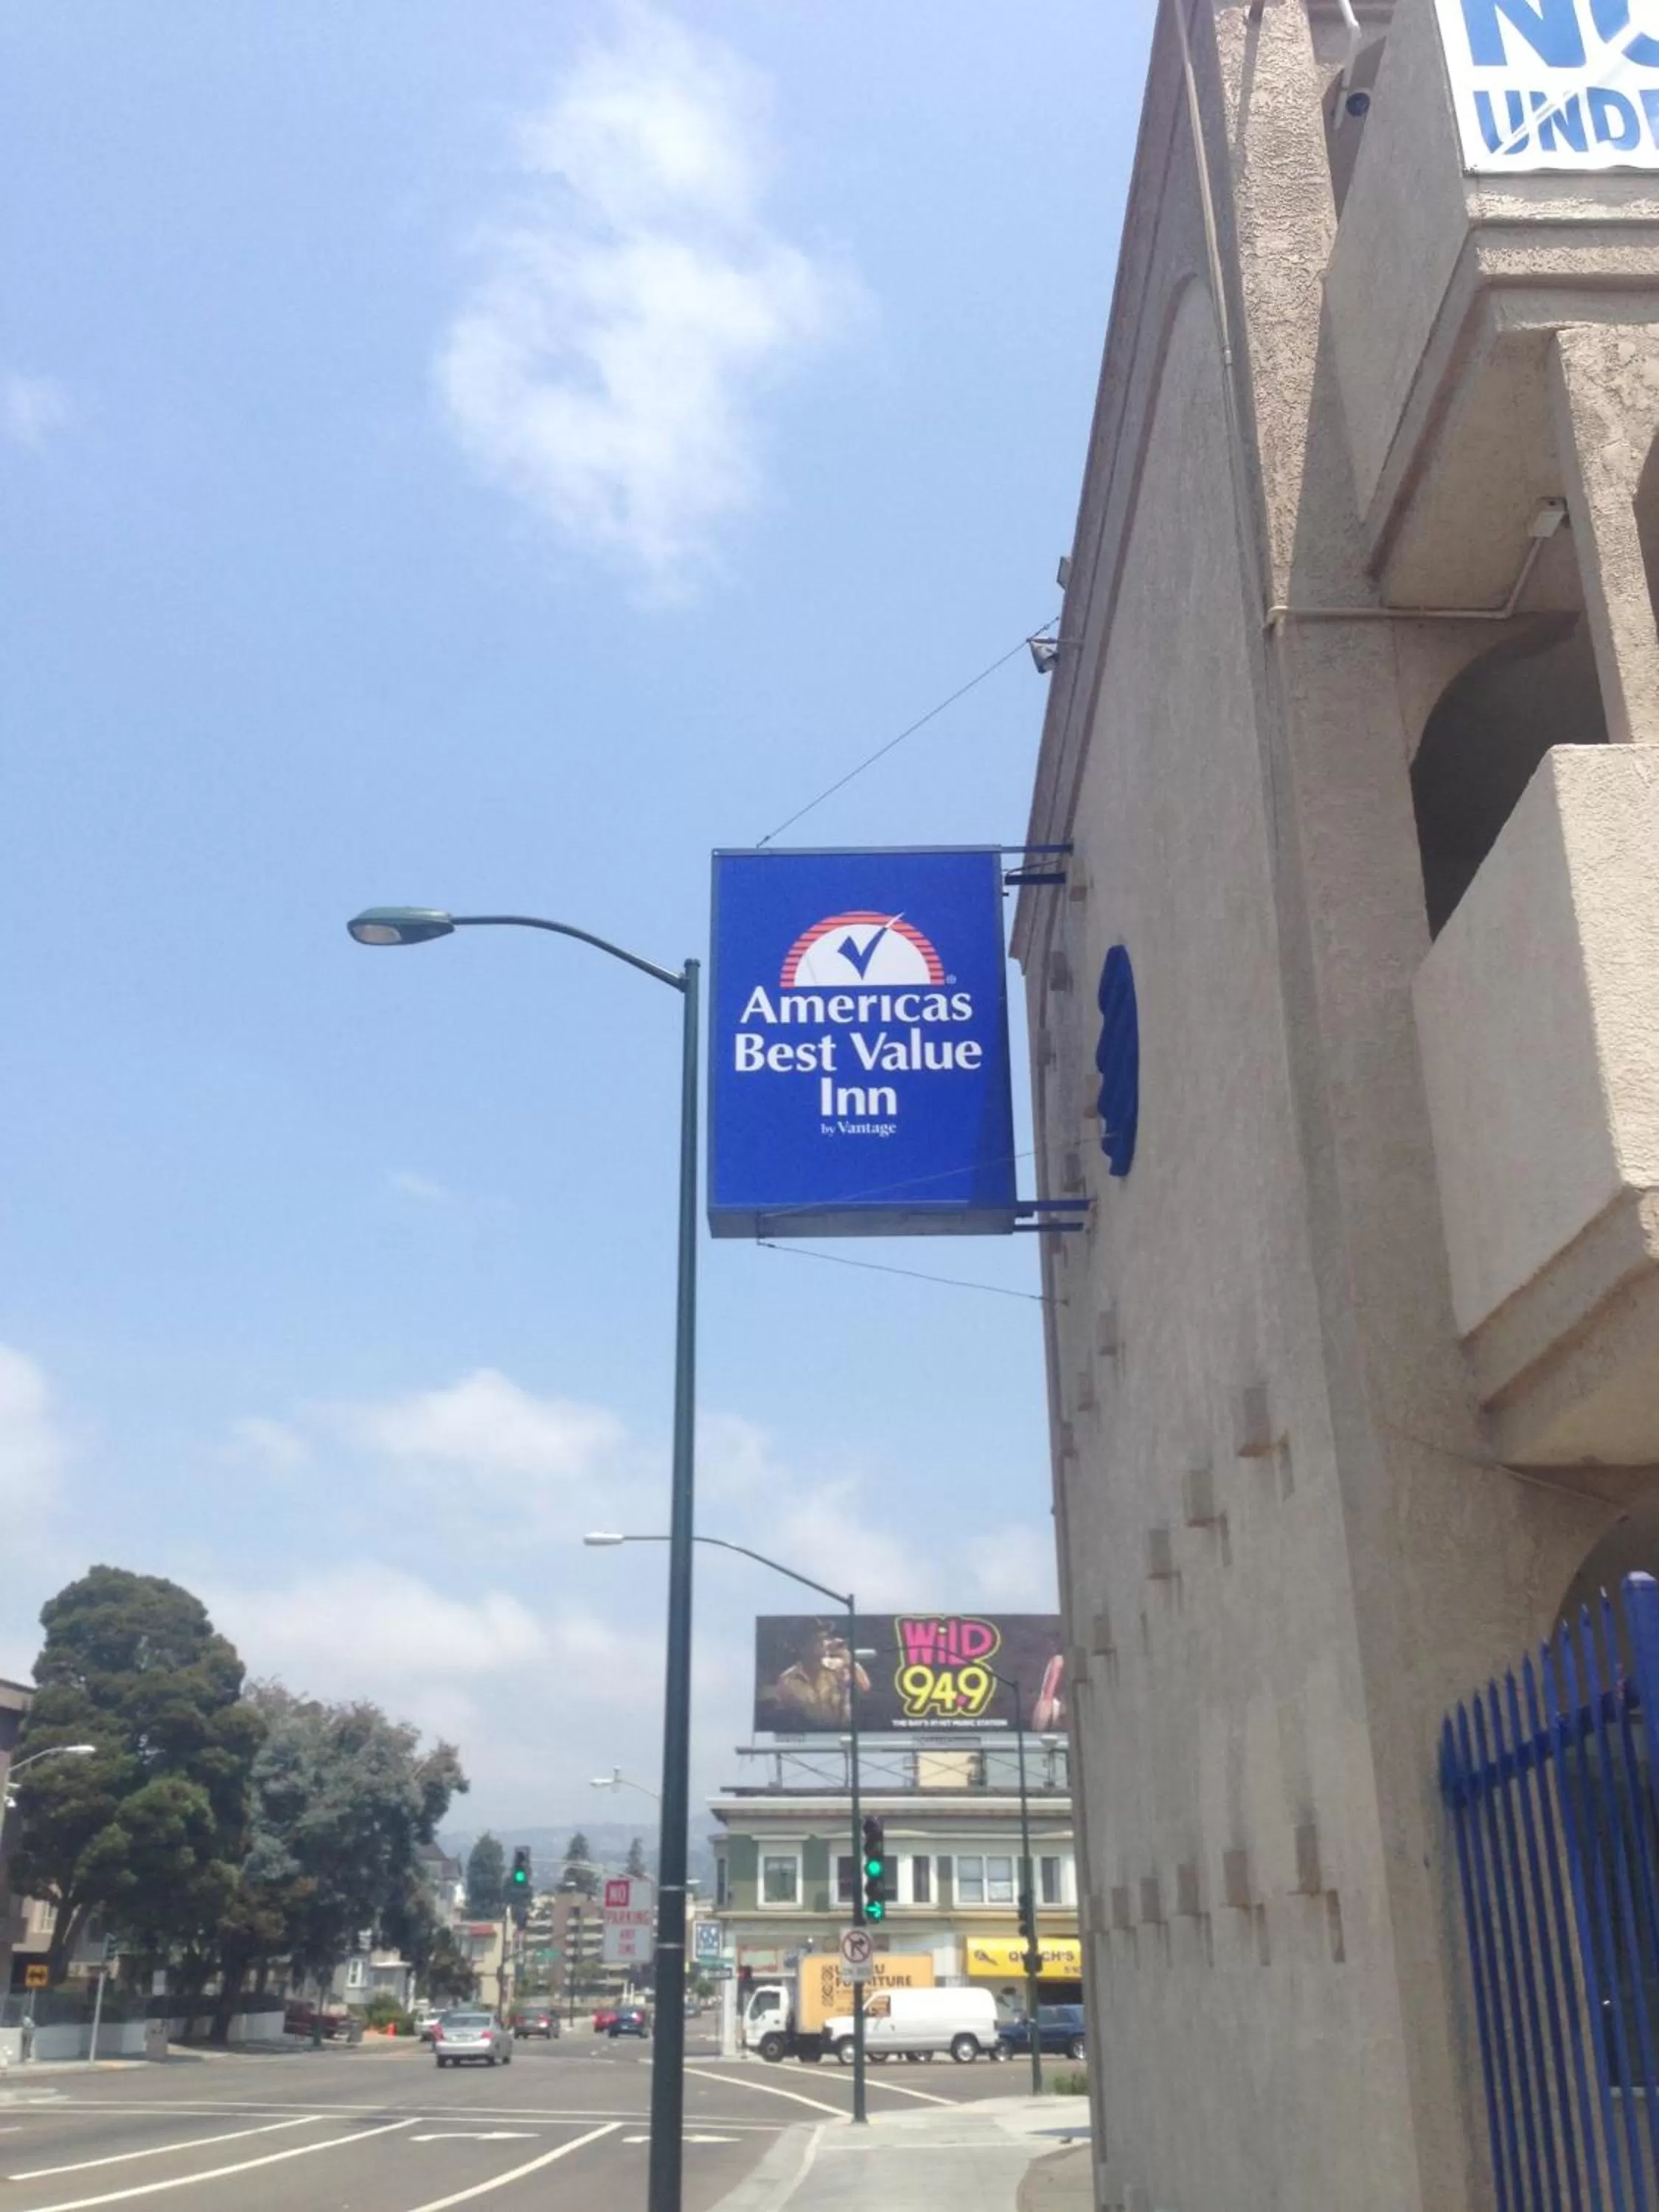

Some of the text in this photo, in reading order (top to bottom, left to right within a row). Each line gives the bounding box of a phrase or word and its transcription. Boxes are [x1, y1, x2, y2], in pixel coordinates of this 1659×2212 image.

[740, 986, 973, 1023] Americas
[734, 1028, 983, 1071] Best Value
[821, 1077, 897, 1116] Inn
[821, 1120, 897, 1138] by Vantage
[609, 1885, 627, 1904] NO
[1009, 1950, 1074, 1962] QCH'S
